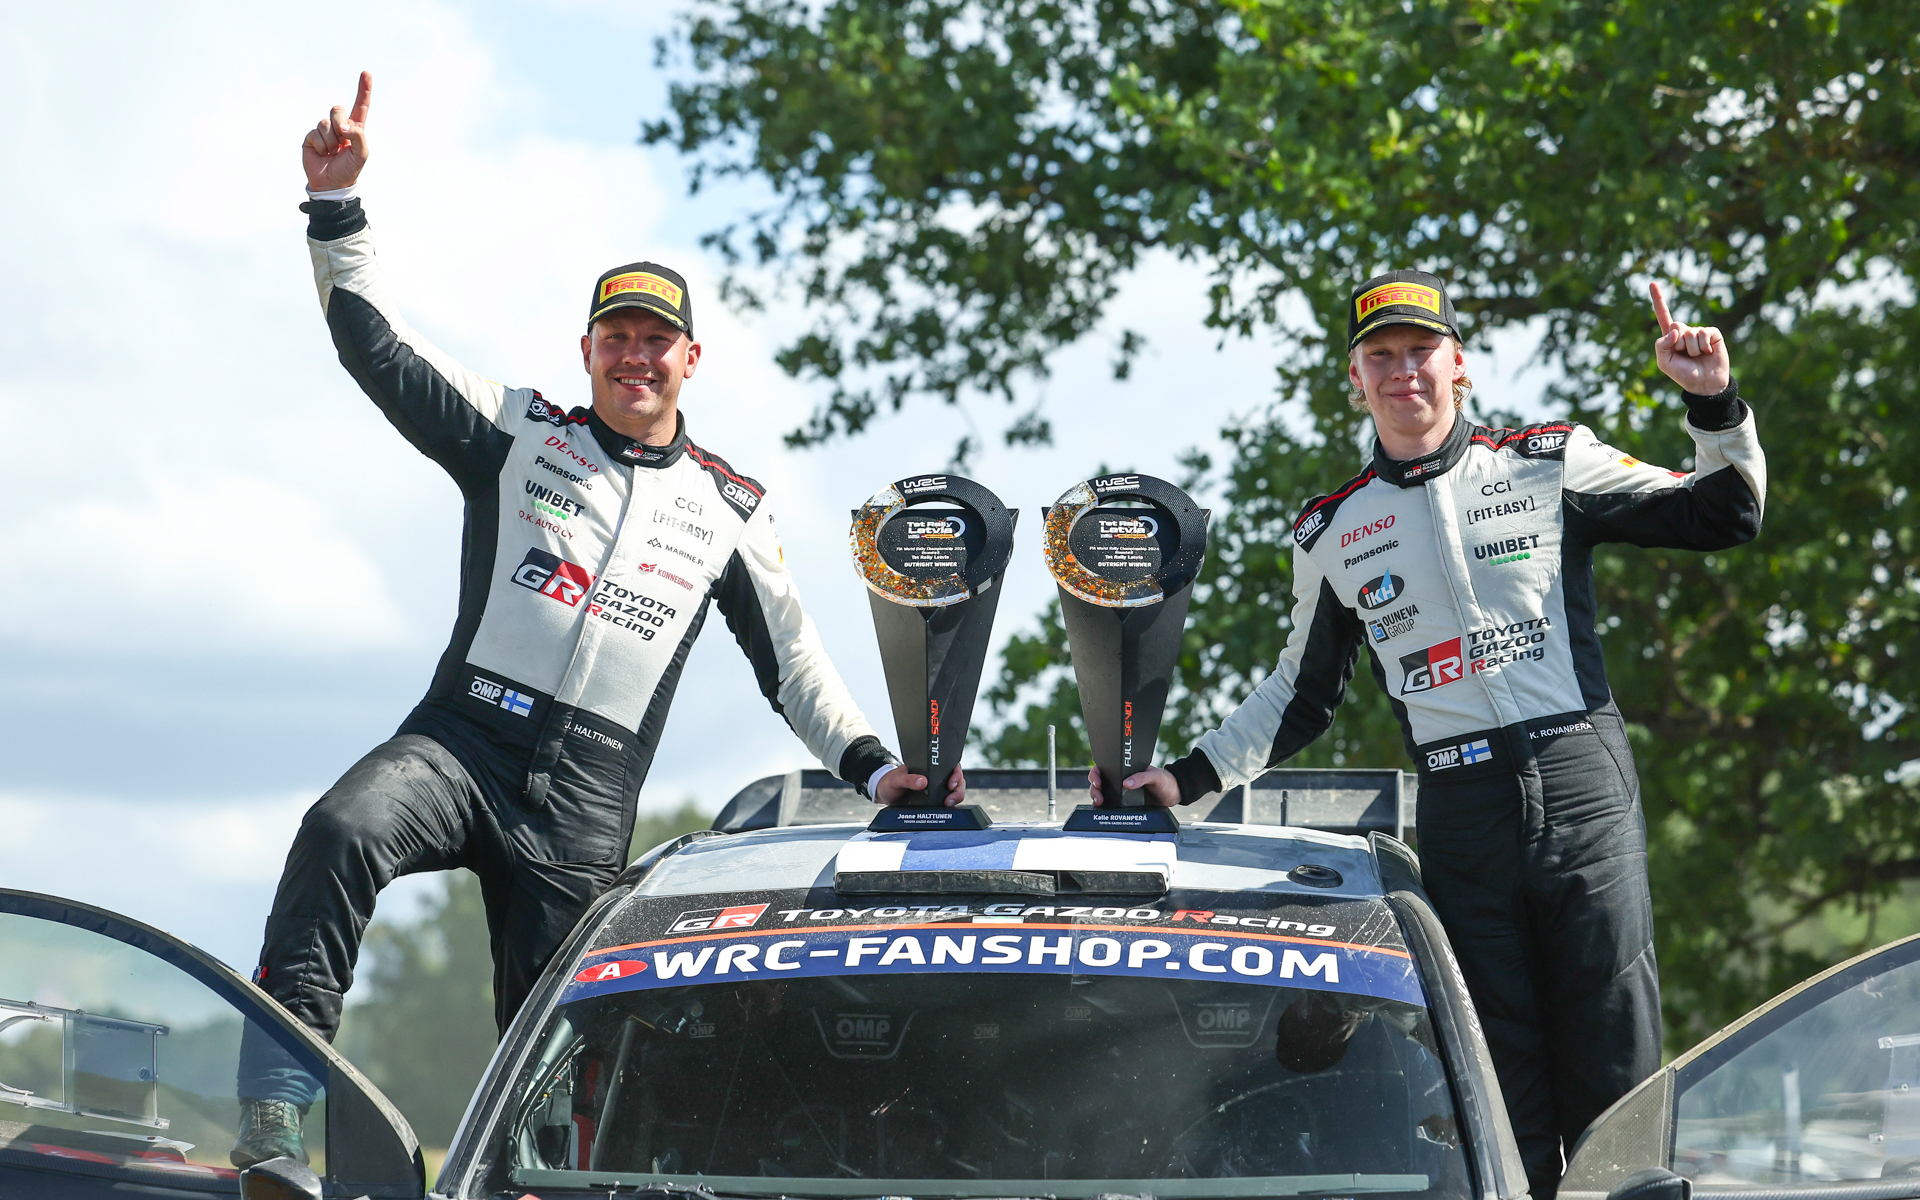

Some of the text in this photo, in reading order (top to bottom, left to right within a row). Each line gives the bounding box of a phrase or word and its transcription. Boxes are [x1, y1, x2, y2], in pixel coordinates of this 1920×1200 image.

[605, 276, 677, 302] PIRELLI
[1360, 286, 1434, 315] PIRELLI
[544, 435, 599, 473] DENSO
[1528, 434, 1565, 451] OMP
[534, 455, 593, 490] Panasonic
[903, 476, 947, 489] WRC
[1095, 475, 1139, 487] WRC
[525, 479, 585, 517] UNIBET
[723, 482, 756, 509] OMP
[535, 518, 560, 533] AUTO
[561, 530, 574, 540] CY
[1100, 526, 1146, 534] Latvia
[1119, 520, 1145, 528] Rally
[1296, 513, 1323, 541] OMP
[1341, 515, 1395, 548] DENSO
[665, 544, 704, 566] MARINE.FI
[1344, 540, 1399, 569] Panasonic
[1474, 534, 1540, 560] UNIBET
[515, 563, 585, 605] GR
[657, 569, 694, 591] KONNEGROUP
[592, 592, 665, 628] GAZOO
[602, 580, 677, 619] TOYOTA
[584, 603, 656, 641] Racing
[1382, 604, 1419, 627] OUNEVA
[1388, 618, 1415, 638] GROUP
[1468, 616, 1551, 645] TOYOTA
[1469, 632, 1545, 659] GAZOO
[1471, 647, 1545, 674] Racing
[1403, 656, 1462, 692] GR
[471, 680, 501, 700] OMP
[564, 721, 624, 751] J. HALTTUNEN
[1529, 731, 1539, 740] K.
[931, 737, 939, 766] FULL
[1427, 749, 1459, 770] OMP
[672, 913, 757, 932] GR
[778, 903, 1337, 938] TOYOTA GAZOO Racing
[597, 962, 621, 980] A
[653, 935, 1340, 984] WRC-FANSHOP.COM
[1065, 1007, 1091, 1019] OMP
[1197, 1008, 1250, 1029] OMP
[689, 1024, 715, 1037] OMP
[836, 1018, 890, 1039] OMP
[974, 1025, 999, 1037] OMP
